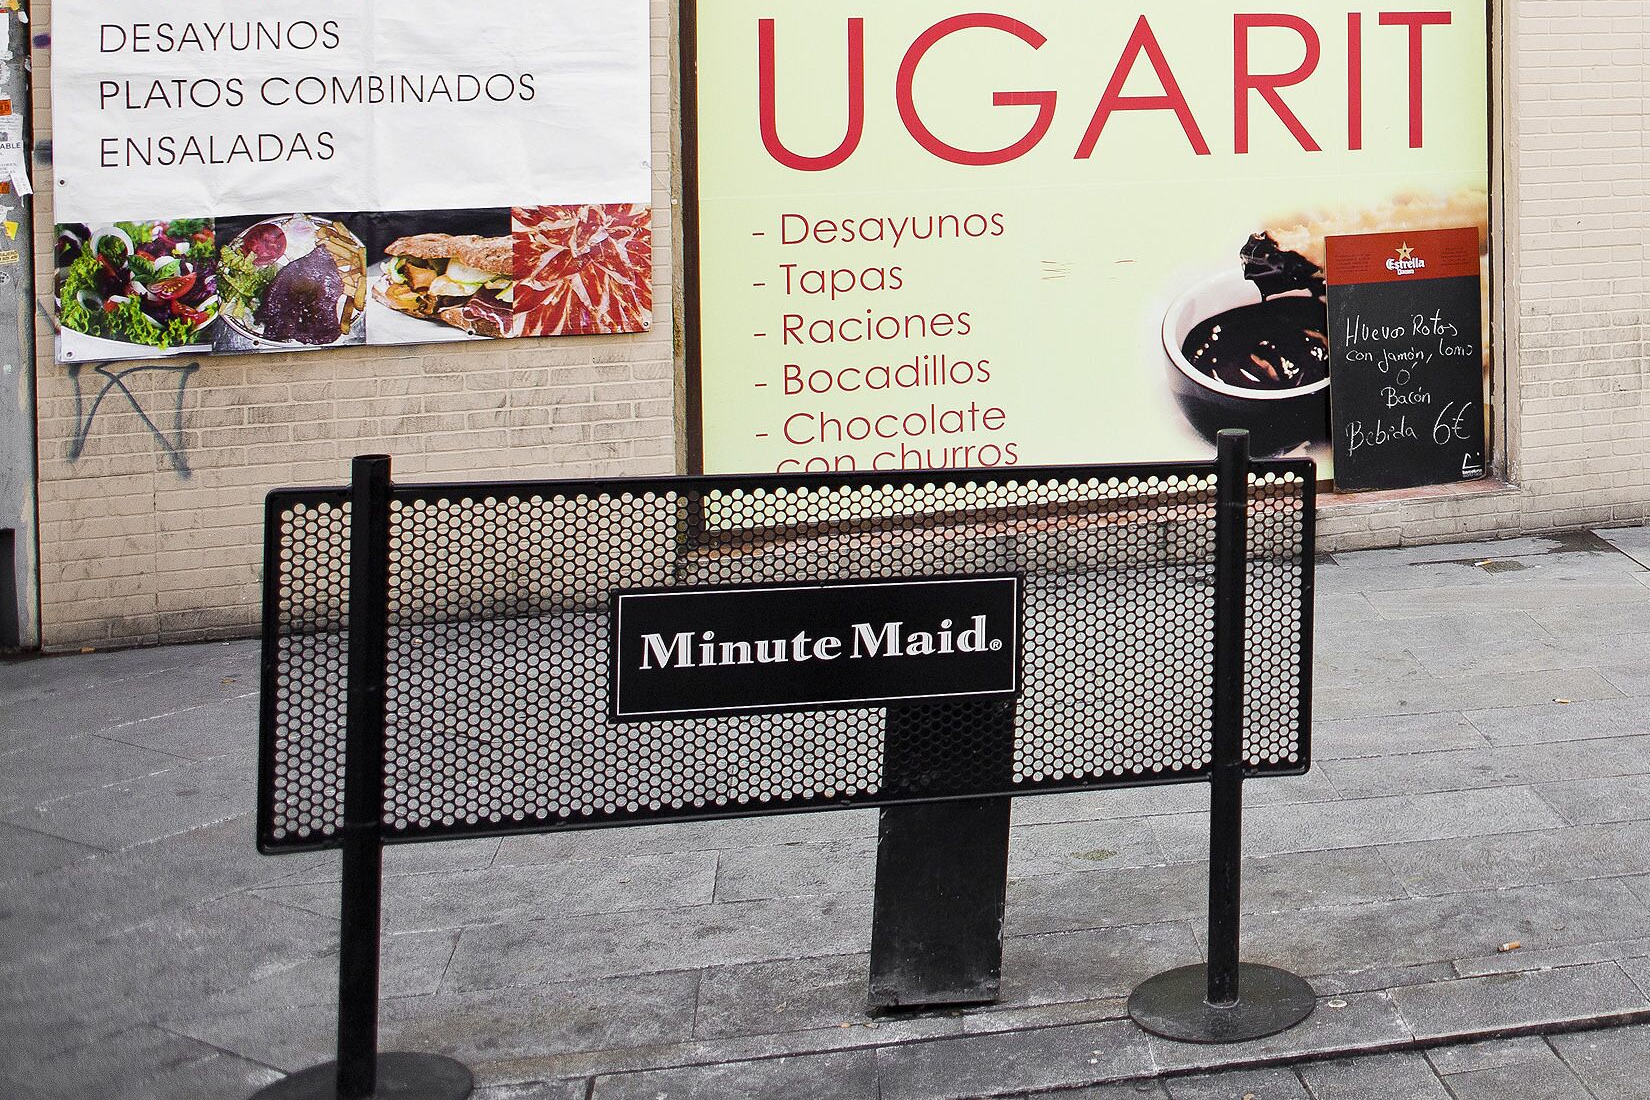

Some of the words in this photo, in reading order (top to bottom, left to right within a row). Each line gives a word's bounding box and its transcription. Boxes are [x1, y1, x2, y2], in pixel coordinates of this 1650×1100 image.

[101, 21, 339, 52] DESAYUNOS
[100, 78, 243, 109] PLATOS
[261, 74, 534, 105] COMBINADOS
[758, 11, 1451, 171] UGARIT
[101, 132, 334, 167] ENSALADAS
[782, 213, 1004, 248] Desayunos
[780, 264, 903, 300] Tapas
[1385, 258, 1426, 270] Estrella
[784, 309, 971, 345] Raciones
[784, 355, 991, 395] Bocadillos
[784, 402, 1006, 445] Chocolate
[1433, 402, 1472, 445] 6€
[872, 441, 1019, 471] churros
[639, 631, 841, 669] Minute
